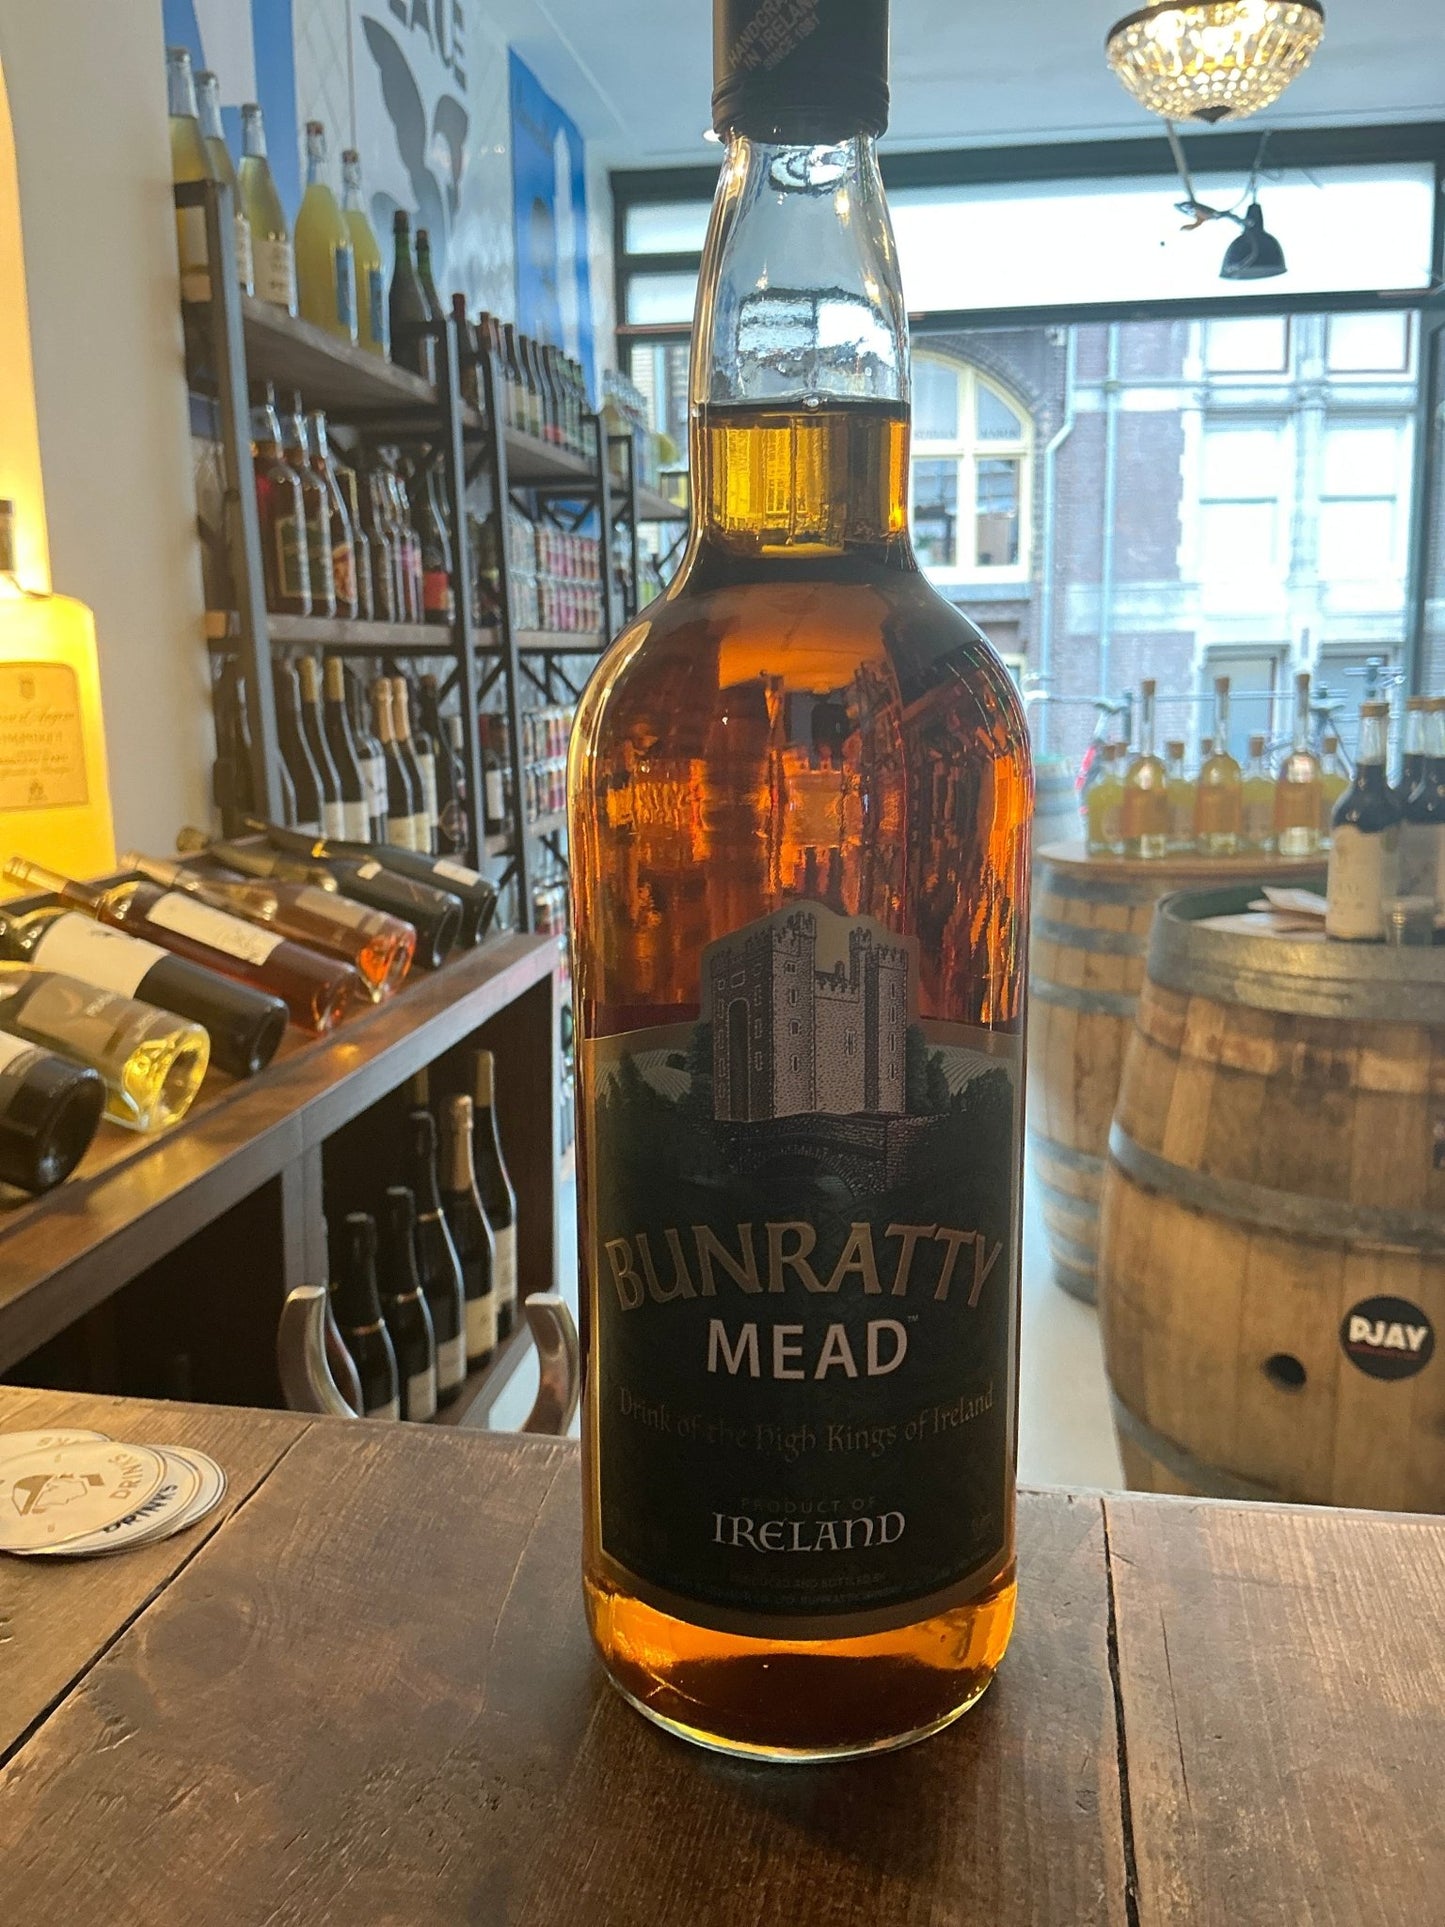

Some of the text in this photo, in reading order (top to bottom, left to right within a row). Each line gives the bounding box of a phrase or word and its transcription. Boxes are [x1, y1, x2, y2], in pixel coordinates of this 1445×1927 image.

[762, 35, 798, 72] SINCE
[604, 1221, 1002, 1311] BUNRATTY
[706, 1318, 908, 1380] MEAD
[618, 1386, 671, 1434] Drink
[677, 1413, 702, 1441] of
[705, 1417, 748, 1449] the
[826, 1422, 897, 1458] Kings
[905, 1408, 930, 1442] of
[932, 1382, 994, 1435] Ireland
[740, 1496, 876, 1514] PRODUCT OF
[712, 1511, 906, 1554] IRELAND
